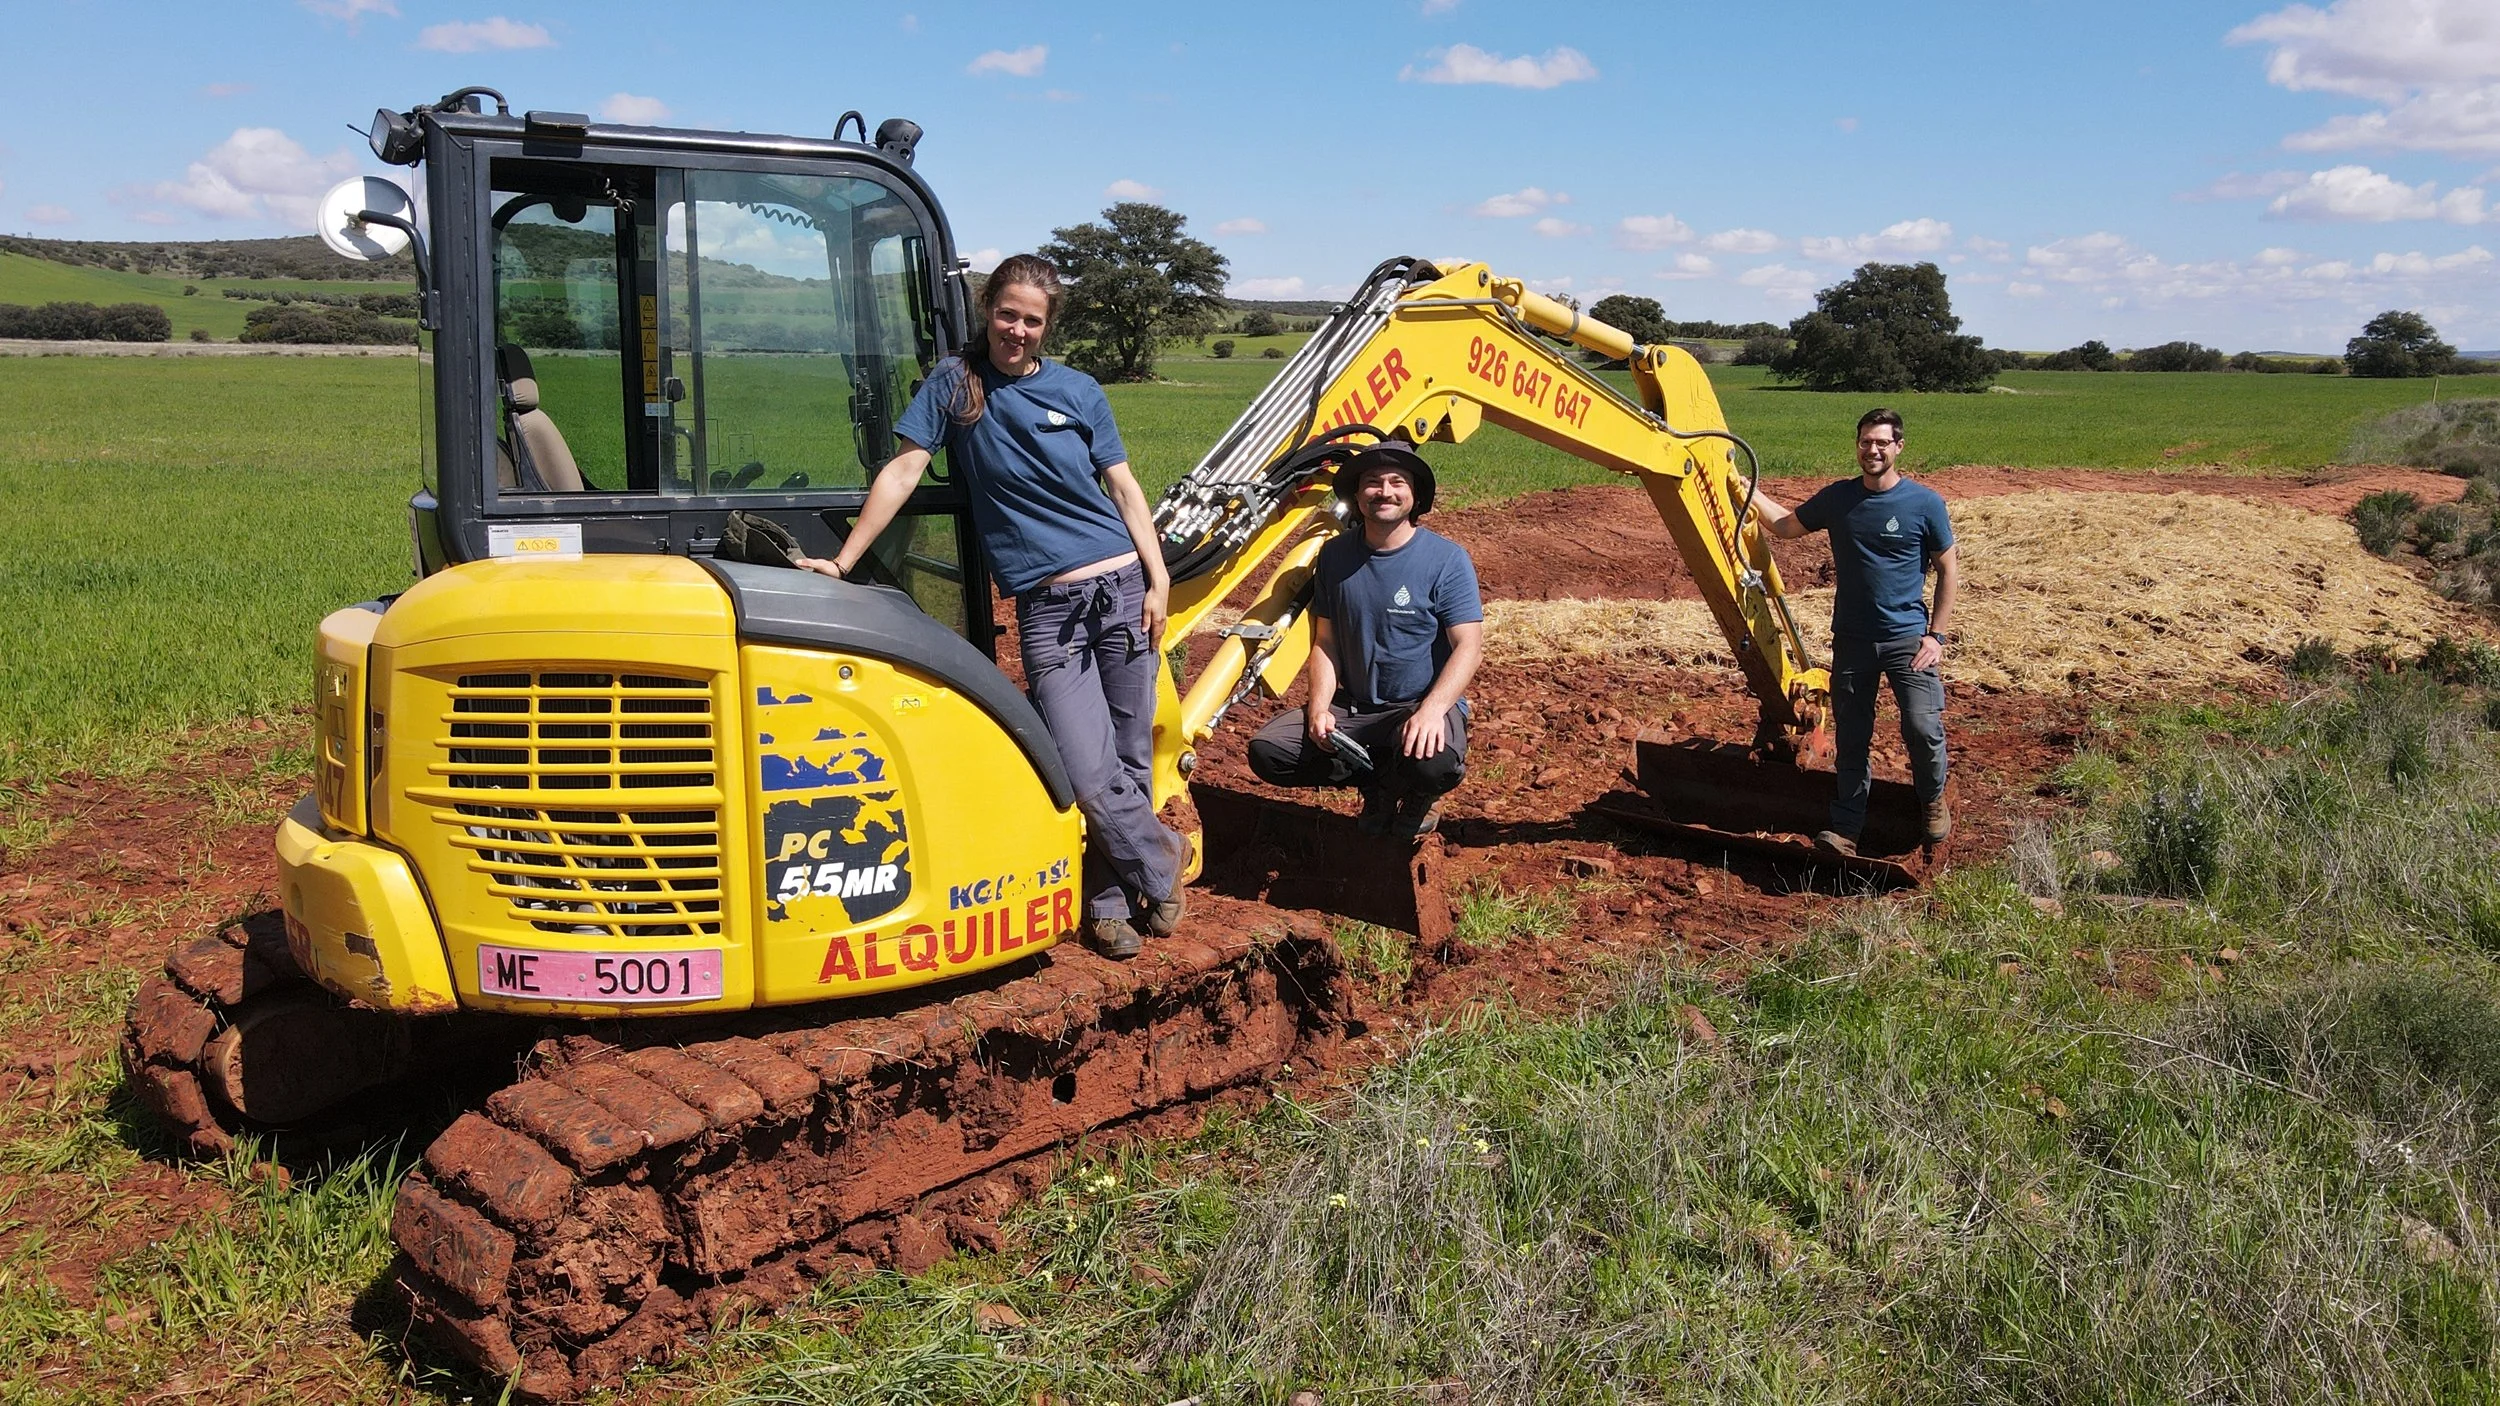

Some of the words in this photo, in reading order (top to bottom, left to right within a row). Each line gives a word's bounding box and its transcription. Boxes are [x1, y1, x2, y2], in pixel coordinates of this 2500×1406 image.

[1467, 335, 1509, 388] 926
[1512, 360, 1553, 409] 647
[1554, 383, 1592, 430] 647
[778, 829, 832, 862] PC
[776, 862, 899, 905] 55MR
[817, 887, 1074, 984] ALQUILER
[496, 952, 541, 993] ME
[595, 957, 691, 995] 5001
